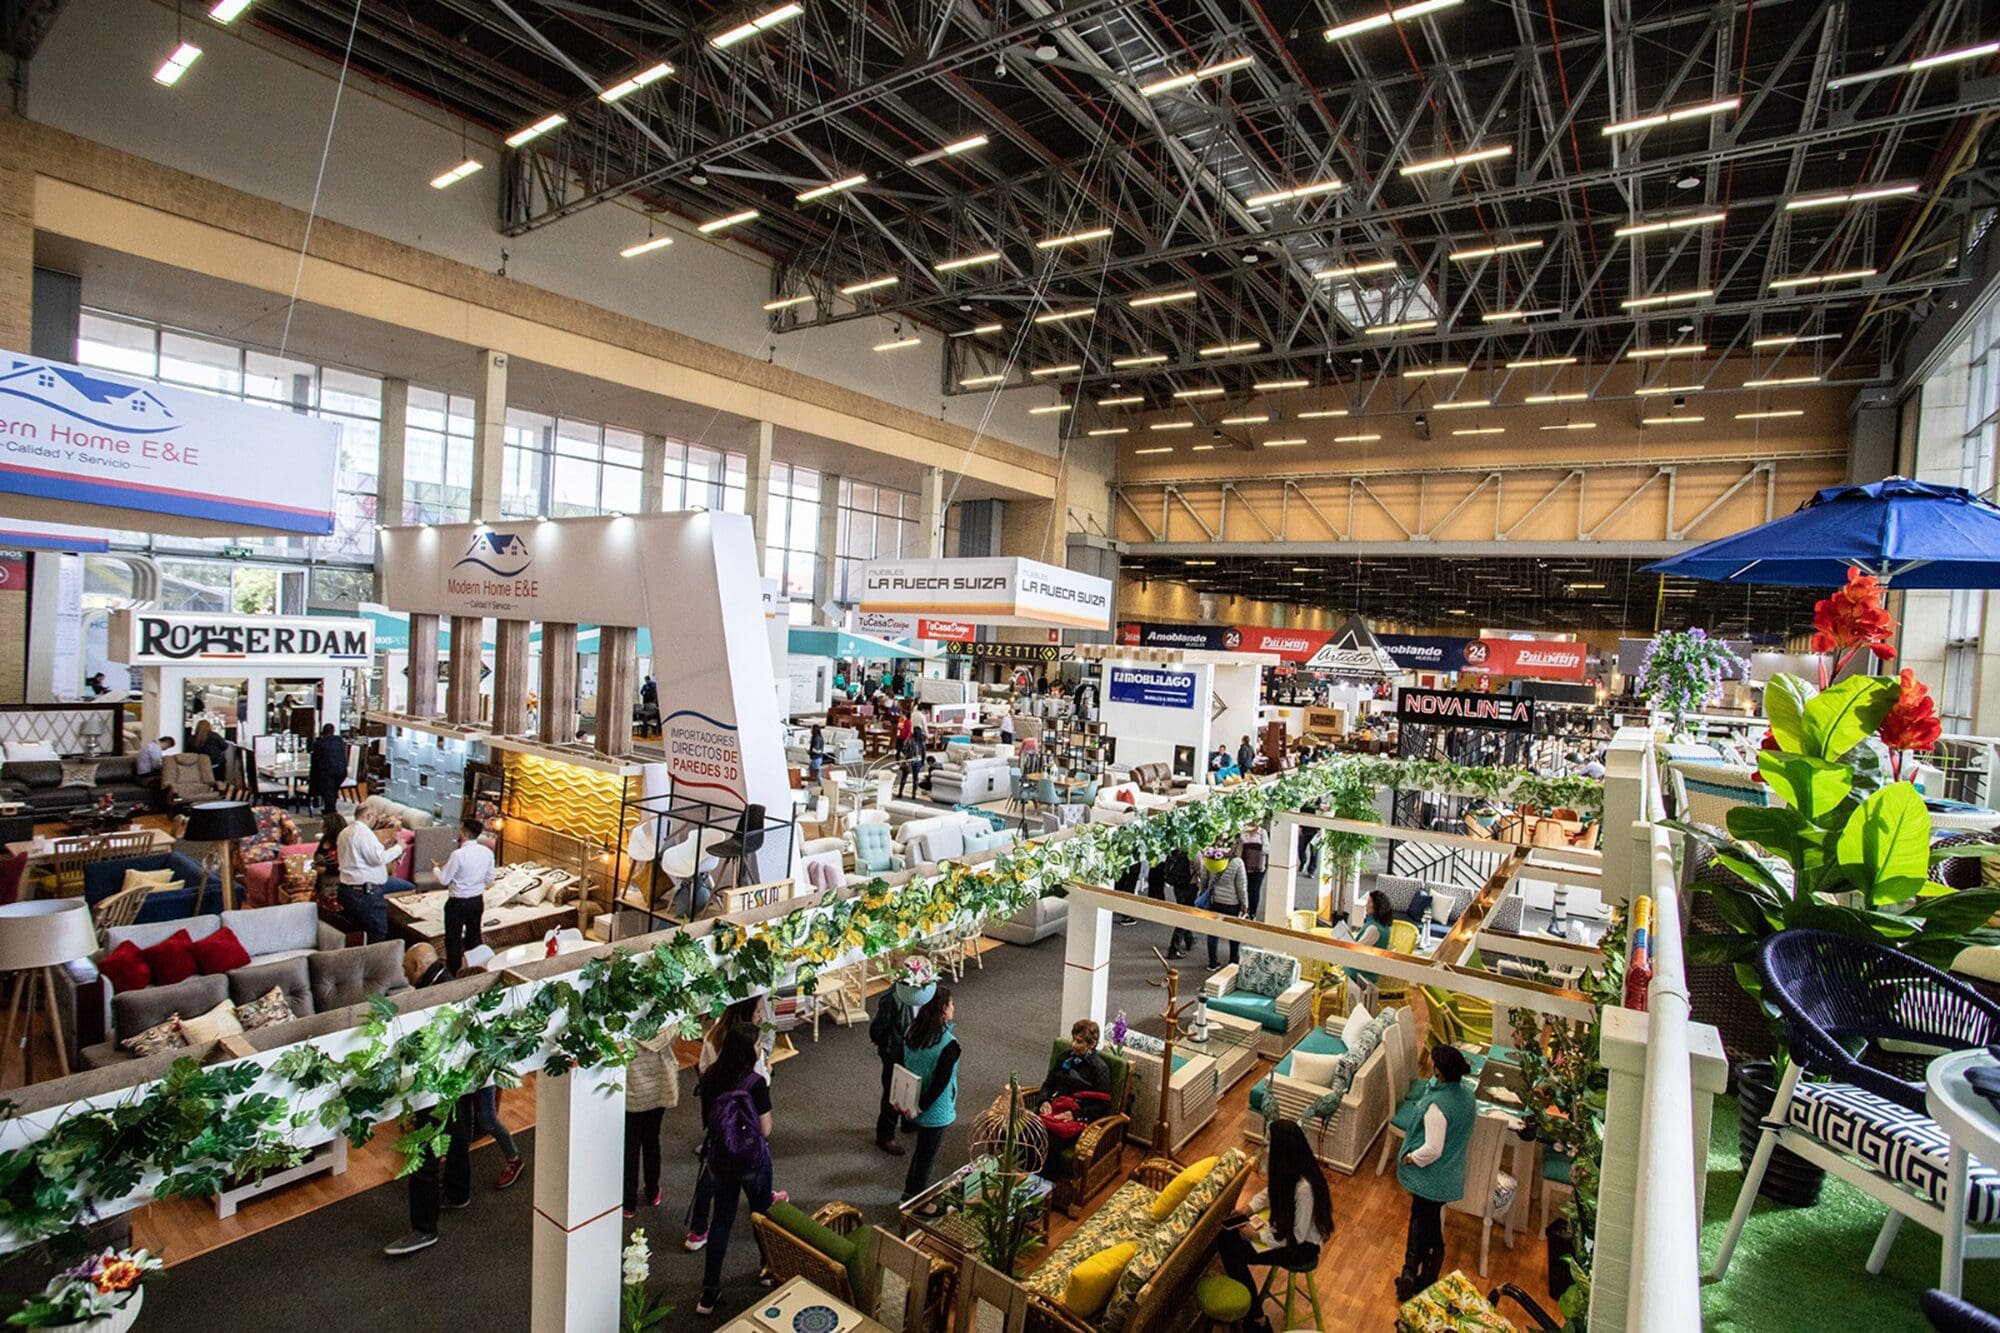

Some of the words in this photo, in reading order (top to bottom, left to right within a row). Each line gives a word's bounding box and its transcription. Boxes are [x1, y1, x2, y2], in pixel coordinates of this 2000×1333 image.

[51, 424, 130, 453] Home
[142, 440, 199, 465] E&E
[6, 441, 60, 458] Calidad
[65, 451, 74, 460] Y
[78, 452, 130, 469] Servicio
[448, 579, 480, 594] Modern
[483, 580, 511, 597] Home
[515, 580, 538, 597] E&E
[868, 578, 889, 589] LA
[893, 578, 949, 589] RUECA
[953, 577, 1006, 589] SUIZA
[1022, 580, 1038, 593] LA
[1040, 583, 1075, 601] RUECA
[1077, 591, 1105, 607] SUIZA
[138, 618, 367, 658] ROTTERDAM
[1148, 632, 1207, 642] Amoblando
[1226, 633, 1240, 645] 24
[966, 643, 1037, 659] BOZZETTI
[1469, 646, 1486, 659] 24
[1405, 694, 1528, 721] NOVALINEA
[671, 728, 735, 747] IMPORTADORES
[672, 741, 722, 761] DIRECTOS
[723, 750, 737, 763] DE
[673, 758, 721, 778] PAREDES
[724, 766, 737, 780] 3D
